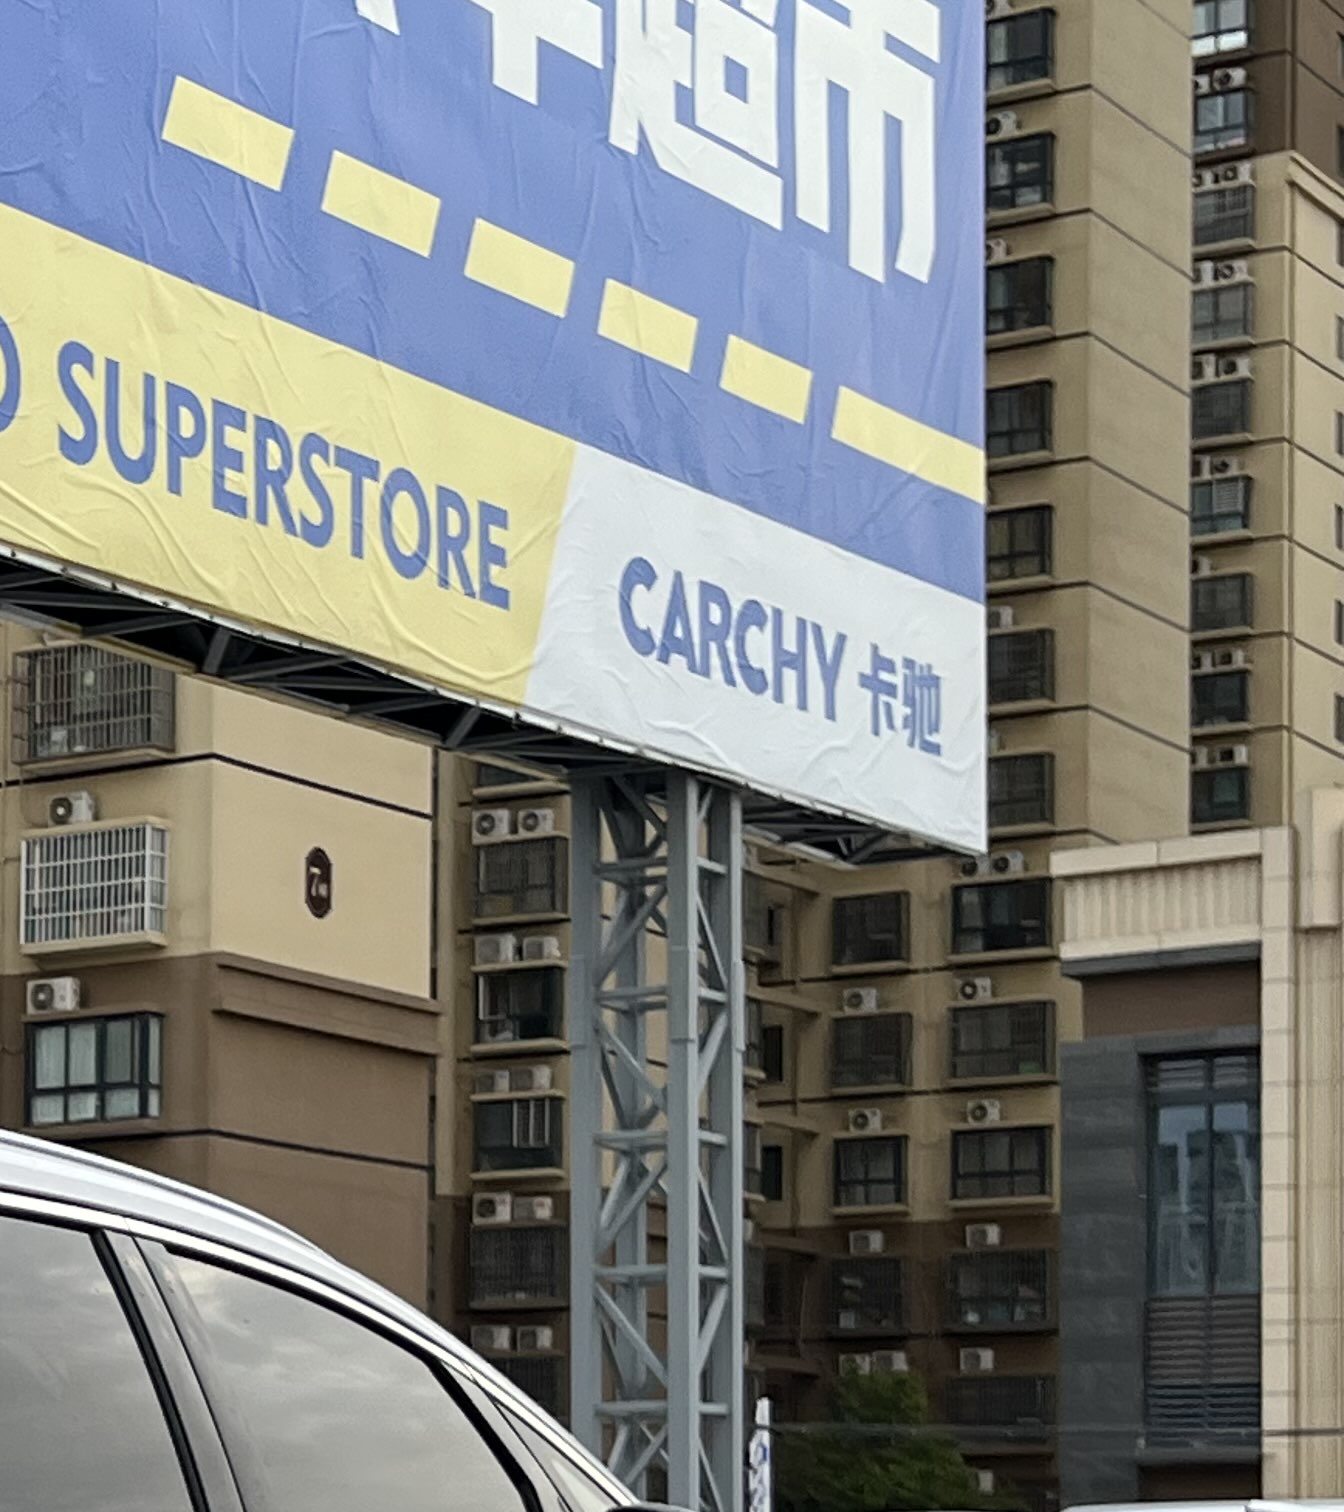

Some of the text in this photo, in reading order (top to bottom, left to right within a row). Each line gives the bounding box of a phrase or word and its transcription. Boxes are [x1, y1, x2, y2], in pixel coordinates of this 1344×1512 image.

[57, 340, 511, 612] SUPERSTORE
[618, 556, 942, 757] CARCHY 卡驰
